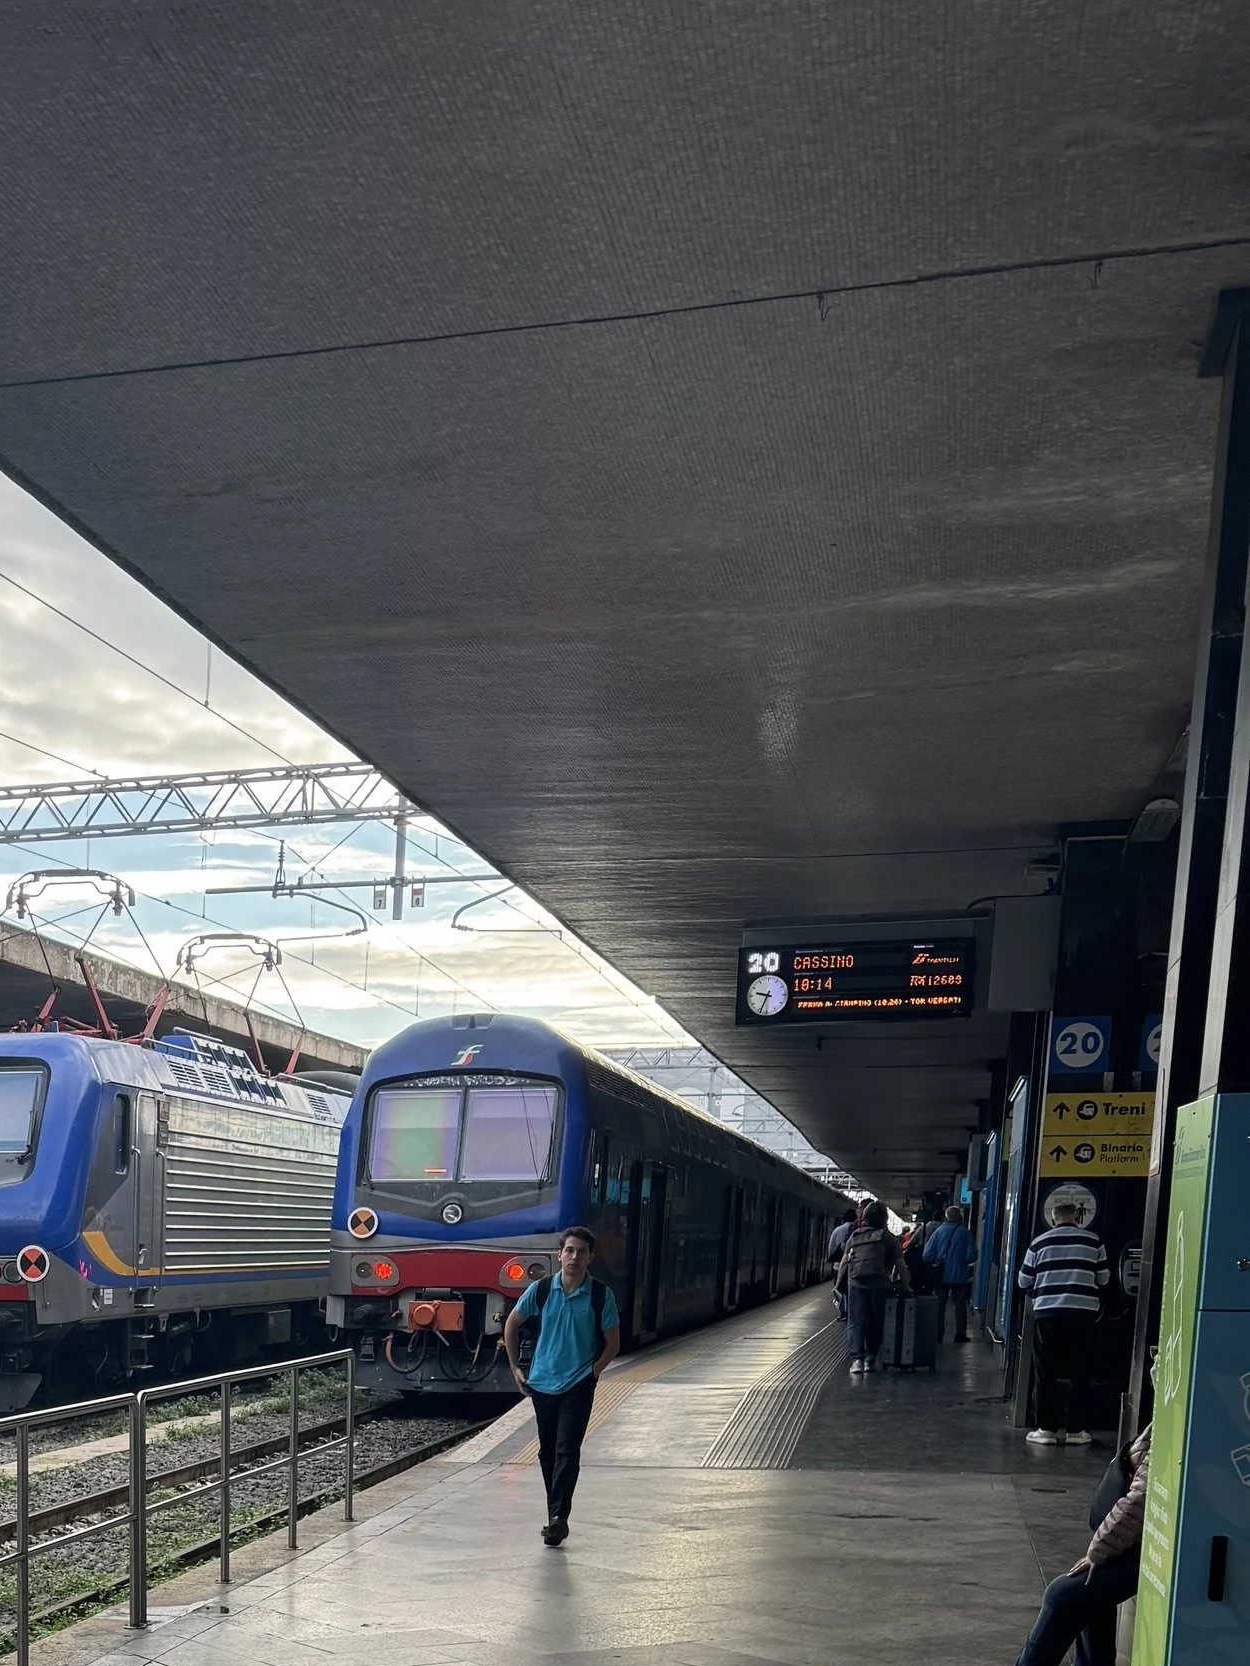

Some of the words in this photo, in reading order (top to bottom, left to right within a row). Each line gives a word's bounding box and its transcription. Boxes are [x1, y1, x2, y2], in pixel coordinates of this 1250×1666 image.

[748, 951, 780, 973] 20
[794, 954, 854, 970] CASSINO
[794, 977, 832, 992] 10:14
[1059, 1032, 1100, 1055] 20
[1103, 1102, 1146, 1116] Treni
[1101, 1143, 1144, 1152] Binario
[1100, 1153, 1139, 1163] Platform
